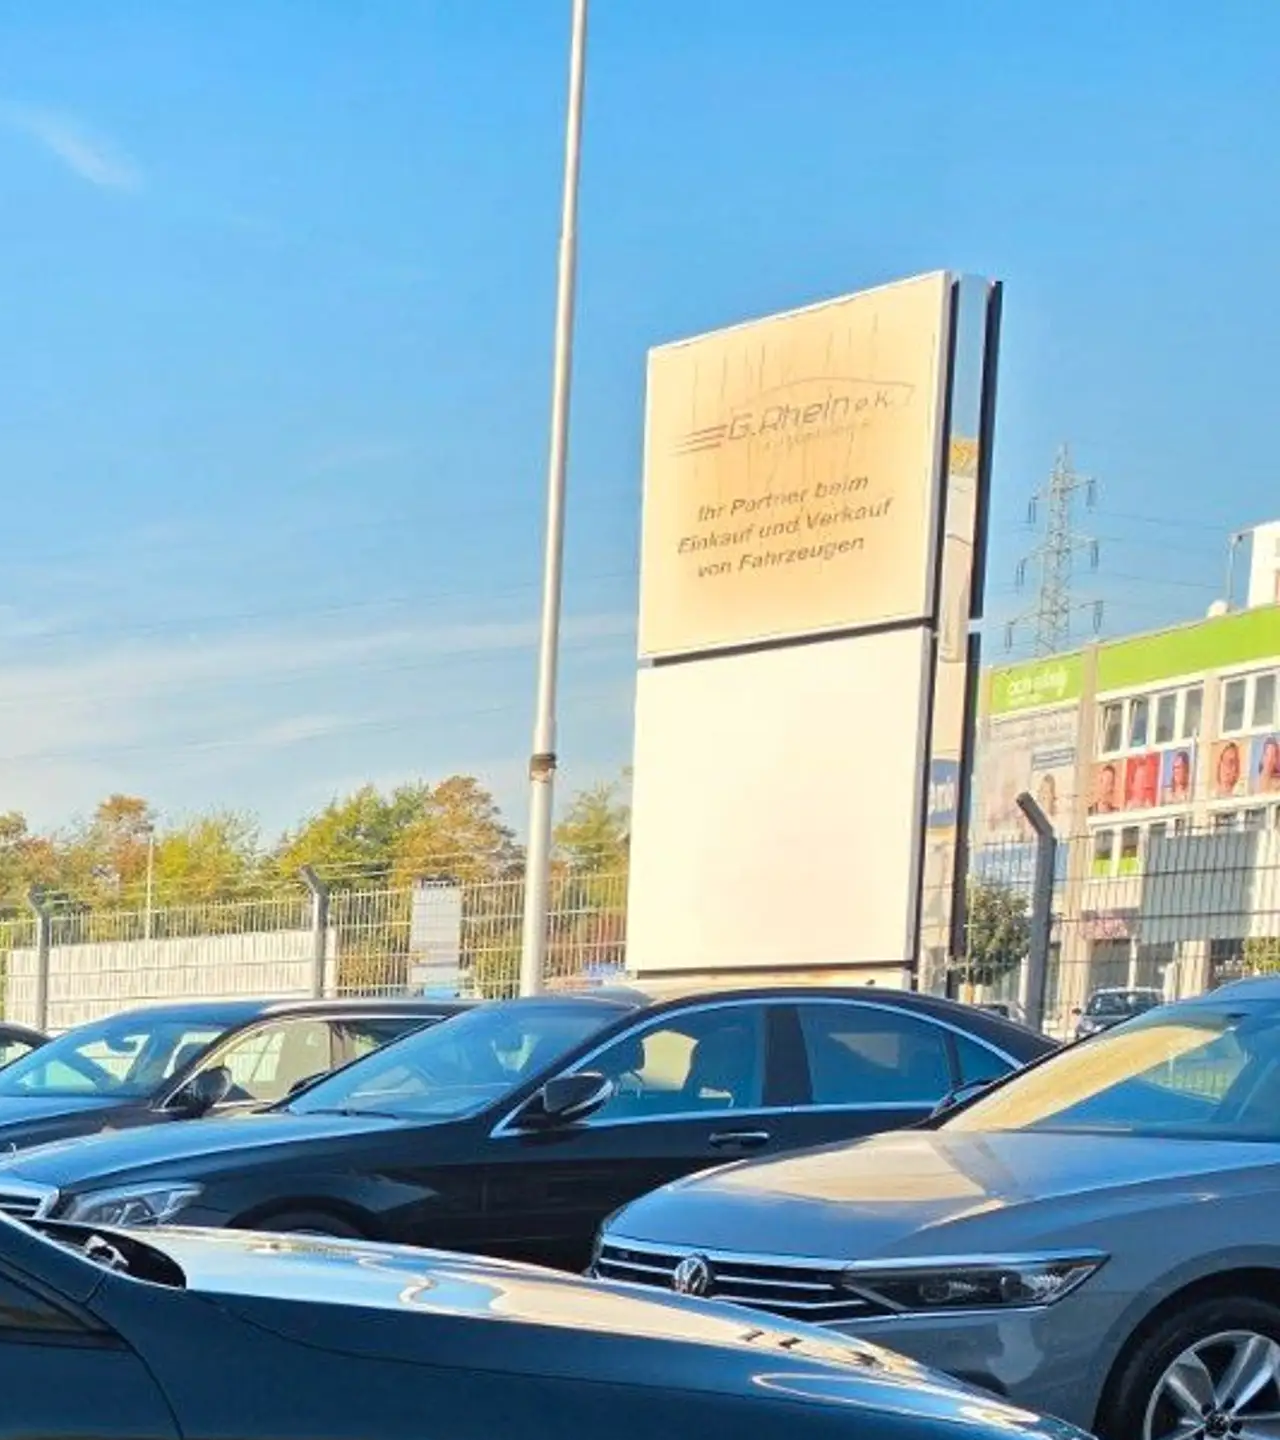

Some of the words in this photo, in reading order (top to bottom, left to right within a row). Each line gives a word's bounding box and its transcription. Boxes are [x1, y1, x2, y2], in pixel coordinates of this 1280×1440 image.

[697, 503, 724, 523] Ihr
[729, 488, 808, 516] Partner
[815, 475, 870, 499] beim
[677, 522, 755, 555] Einkauf
[759, 516, 801, 539] und
[806, 494, 895, 530] Verkauf
[697, 560, 732, 578] von
[737, 534, 865, 573] Fahrzeugen
